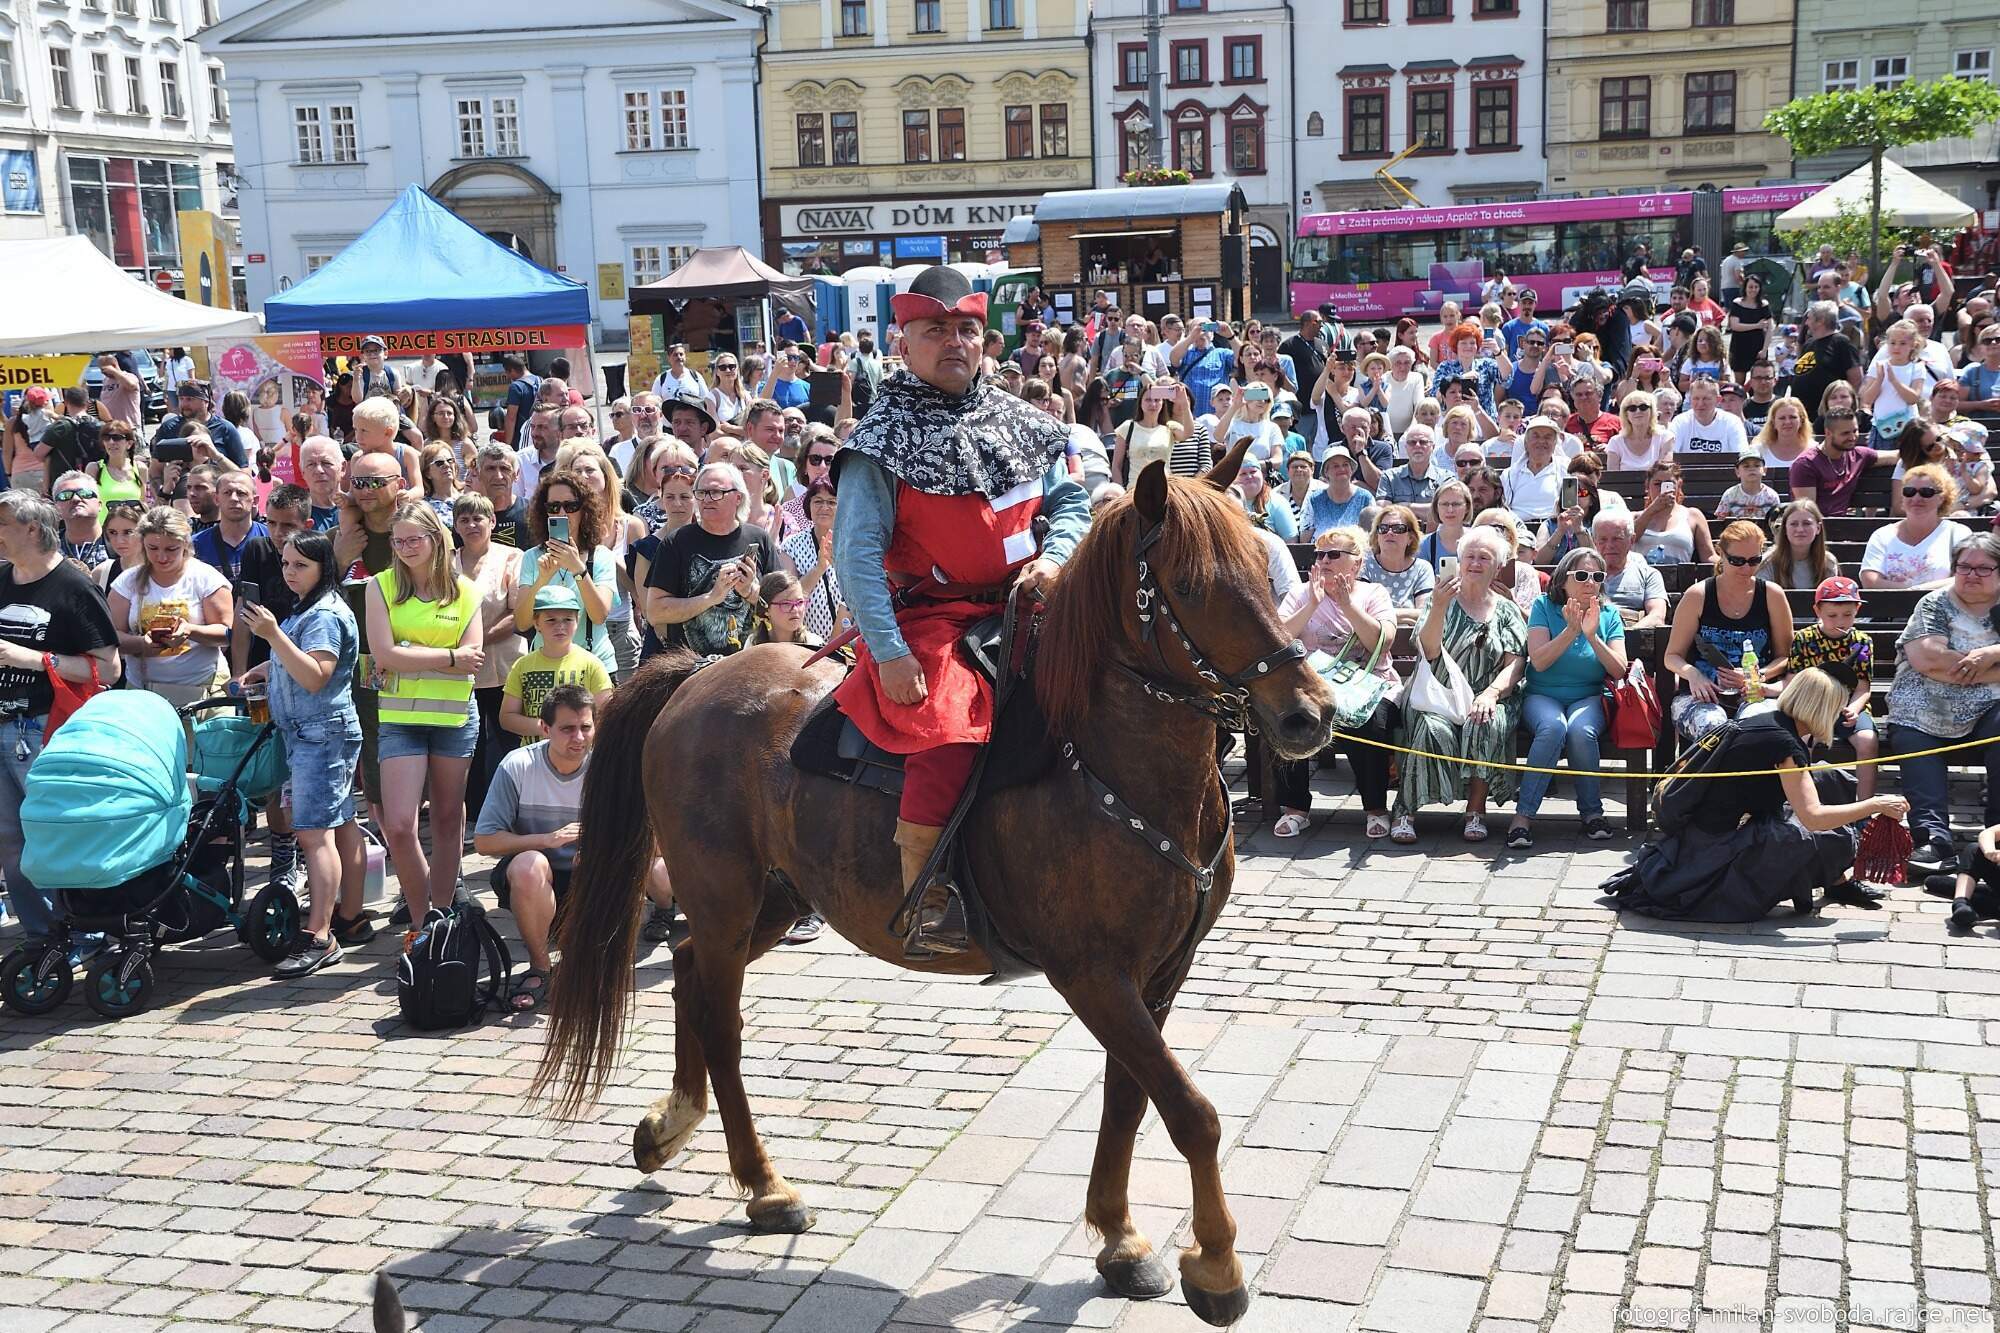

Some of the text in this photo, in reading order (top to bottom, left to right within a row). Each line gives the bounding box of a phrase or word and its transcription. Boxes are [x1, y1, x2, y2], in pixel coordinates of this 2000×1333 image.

[1731, 194, 1769, 205] Navštiv
[1770, 193, 1789, 203] nás
[803, 210, 866, 229] NAVA
[892, 204, 954, 226] DŮM
[1349, 217, 1371, 228] Zažít
[1372, 215, 1414, 228] prémiový
[1415, 213, 1443, 225] nákup
[1446, 211, 1478, 223] Apple?
[1480, 210, 1491, 219] To
[1493, 208, 1526, 219] chceš.
[1595, 275, 1613, 284] Mac
[1338, 303, 1385, 312] stanice Mac.
[319, 332, 437, 351] REGIRACE
